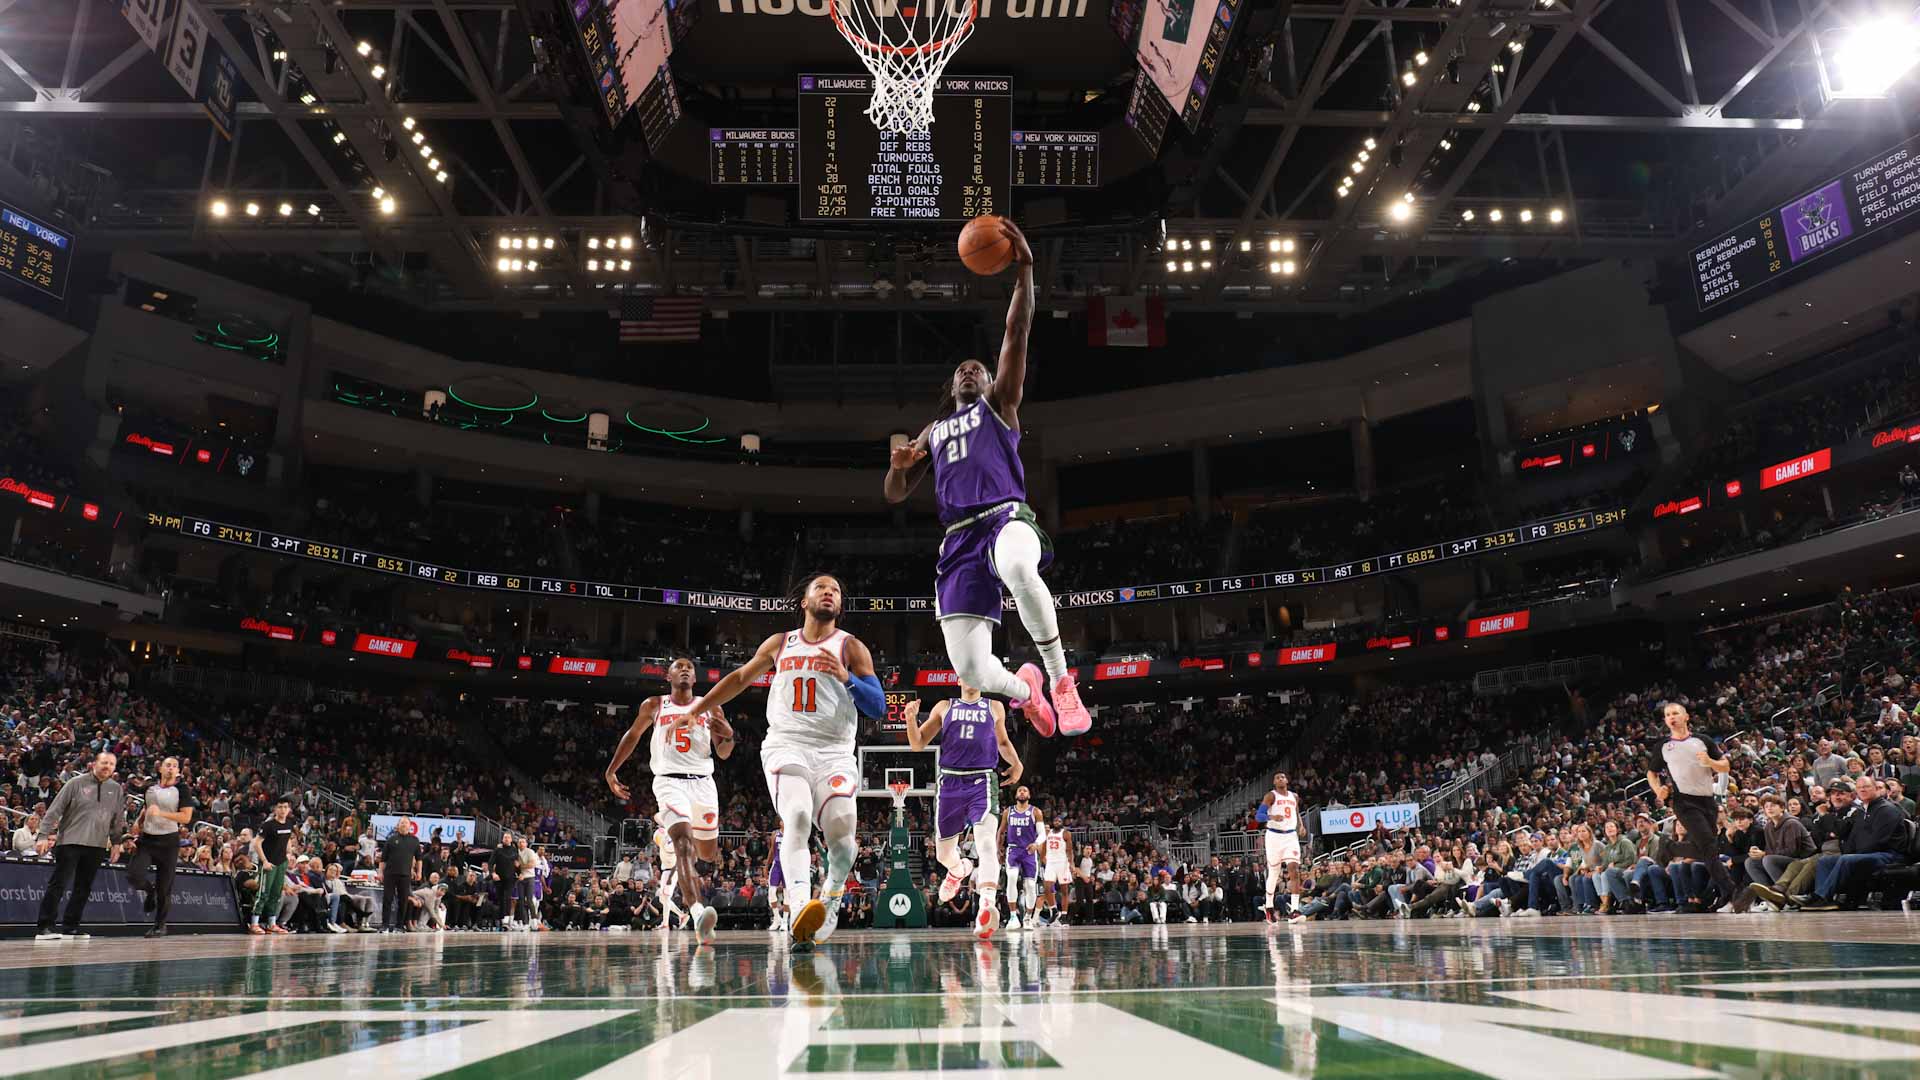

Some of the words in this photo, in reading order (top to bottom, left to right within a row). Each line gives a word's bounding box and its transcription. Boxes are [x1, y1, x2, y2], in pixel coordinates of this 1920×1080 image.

[817, 79, 867, 89] MILWAUKEE
[946, 80, 970, 90] YORK
[974, 81, 1008, 91] KNICKS
[825, 97, 837, 107] 22
[974, 98, 983, 109] 18
[827, 107, 834, 118] 8
[975, 109, 982, 119] 5
[827, 119, 834, 128] 7
[975, 121, 982, 131] 6
[725, 131, 767, 140] MILWAUKEE
[771, 131, 795, 140] BUCKS
[826, 130, 836, 140] 19
[880, 131, 899, 141] OFF
[905, 131, 931, 141] REBS
[974, 132, 983, 142] 13
[1025, 134, 1041, 142] NEW
[1044, 134, 1064, 143] YORK
[1068, 135, 1097, 143] KNICKS
[880, 142, 899, 152] DEF
[905, 142, 931, 152] REBS
[828, 152, 835, 162] 7
[877, 152, 934, 163] TURNOVERS
[974, 154, 982, 164] 12
[825, 163, 837, 173] 24
[871, 163, 902, 174] TOTAL
[908, 164, 940, 174] FOULS
[974, 164, 982, 175] 18
[1853, 149, 1908, 182] TURNOVERS
[826, 173, 839, 183] 28
[868, 174, 900, 185] BENCH
[906, 175, 943, 185] POINTS
[972, 175, 984, 185] 45
[817, 184, 847, 195] 40/107
[871, 185, 902, 196] FIELD
[908, 186, 940, 196] GOALS
[1856, 176, 1879, 194] FAST
[1858, 184, 1888, 205] FIELD
[820, 196, 846, 206] 13/45
[875, 196, 936, 207] 3-POINTERS
[1861, 198, 1886, 216] FREE
[818, 207, 847, 217] 22/27
[871, 207, 896, 217] FREE
[903, 207, 940, 218] THROWS
[1759, 217, 1772, 230] 60
[9, 213, 30, 231] NEW
[36, 226, 60, 247] YORK
[1763, 229, 1772, 239] 19
[1801, 221, 1840, 251] BUCKS
[1696, 235, 1737, 262] REBOUNDS
[1767, 240, 1774, 250] 8
[26, 242, 53, 261] 36/91
[1698, 259, 1713, 272] OFF
[1716, 237, 1757, 263] REBOUNDS
[28, 255, 53, 274] 12/35
[1769, 260, 1781, 272] 22
[21, 266, 51, 286] 22/32
[1700, 261, 1731, 282] BLOCKS
[1702, 271, 1734, 292] STEALS
[1704, 280, 1740, 303] ASSISTS
[1872, 427, 1909, 448] Bally
[946, 435, 968, 464] 21
[1776, 464, 1800, 481] GAME
[1801, 458, 1814, 473] ON
[1653, 501, 1681, 518] Bally
[148, 513, 162, 527] 34
[166, 517, 180, 529] PM
[1596, 511, 1619, 525] 9:34
[194, 522, 211, 535] FG
[218, 526, 253, 544] 37.4%
[1532, 525, 1547, 538] FG
[1552, 517, 1587, 534] 39.6%
[271, 537, 300, 552] 3-PT
[307, 543, 339, 560] 28.9%
[1452, 539, 1478, 554] 3-PT
[1484, 532, 1516, 548] 34.3%
[352, 553, 367, 565] FT
[377, 557, 403, 572] 81.5%
[1389, 555, 1402, 567] FT
[1406, 549, 1435, 564] 68.8%
[418, 566, 438, 579] AST
[444, 571, 457, 582] 22
[1334, 565, 1353, 578] AST
[1361, 562, 1371, 573] 18
[477, 575, 498, 586] REB
[506, 578, 520, 589] 60
[1275, 573, 1295, 585] REB
[1302, 571, 1315, 582] 54
[541, 580, 562, 592] FLS
[570, 584, 576, 593] 5
[1170, 585, 1189, 595] TOL
[1195, 583, 1201, 593] 2
[1222, 579, 1242, 590] FLS
[595, 585, 613, 597] TOL
[1136, 588, 1157, 598] BONUS
[687, 593, 753, 610] MILWAUKEE
[869, 599, 894, 610] 30.4
[909, 600, 927, 609] QTR
[1069, 591, 1114, 607] KNICKS
[1480, 618, 1502, 633] GAME
[1503, 616, 1515, 629] ON
[368, 639, 390, 652] GAME
[391, 643, 403, 654] ON
[1291, 649, 1312, 661] GAME
[1313, 648, 1324, 660] ON
[563, 661, 584, 672] GAME
[585, 662, 596, 673] ON
[781, 656, 807, 671] NEW
[1106, 665, 1126, 677] GAME
[1127, 664, 1137, 675] ON
[927, 673, 947, 683] GAME
[792, 677, 816, 713] 11
[885, 695, 906, 705] 30.2
[952, 708, 987, 723] BUCKS
[961, 724, 974, 739] 12
[676, 728, 691, 753] 5
[1284, 806, 1292, 819] 9
[1010, 816, 1030, 827] BUCKS
[1329, 816, 1348, 826] BMO
[1016, 827, 1022, 836] 5
[1049, 841, 1059, 849] 23
[182, 891, 203, 906] Silver
